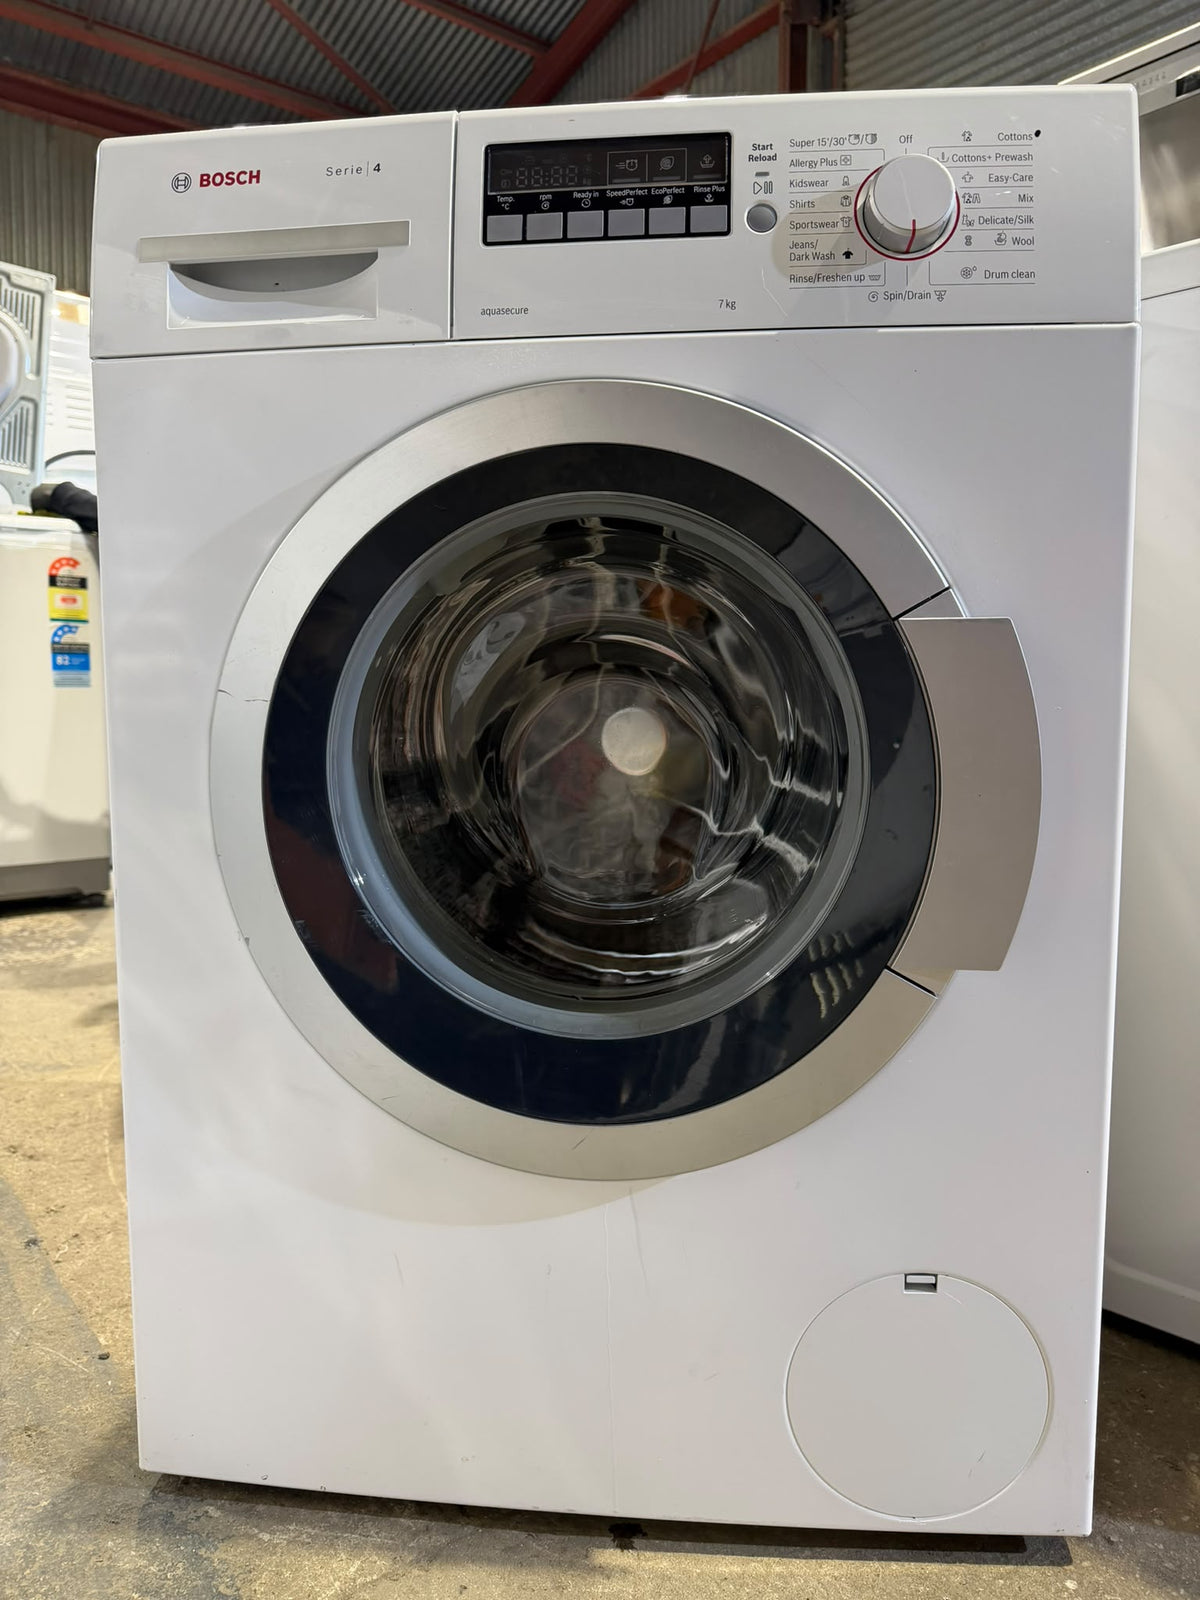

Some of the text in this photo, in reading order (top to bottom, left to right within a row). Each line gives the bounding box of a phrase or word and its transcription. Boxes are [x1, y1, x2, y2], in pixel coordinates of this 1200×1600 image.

[899, 134, 913, 144] Off
[998, 132, 1033, 141] Cottons
[752, 143, 773, 151] Start
[790, 138, 815, 149] Super
[748, 153, 777, 162] Reload
[952, 152, 1033, 163] Cottons+ Prewash
[789, 158, 838, 169] Allergy Plus
[326, 163, 381, 176] Serie 4
[200, 170, 261, 188] BOSCH
[790, 178, 828, 188] Kidswear
[606, 188, 648, 197] SpeedPerfect
[651, 187, 685, 196] EcoPerfect
[496, 195, 515, 204] Temp.
[1018, 194, 1034, 203] Mix
[790, 200, 815, 208] Shirts
[978, 214, 1034, 225] Delicate/Silk
[790, 220, 839, 230] Sportswear
[789, 240, 818, 249] Jeans/
[1012, 236, 1035, 246] Wool
[790, 251, 835, 261] Dark Wash
[790, 273, 865, 284] Rinse/Freshen up
[984, 269, 1036, 279] Drum clean
[883, 290, 931, 302] Spin/Drain
[718, 299, 736, 310] 7 kg
[480, 306, 529, 317] aquasecure
